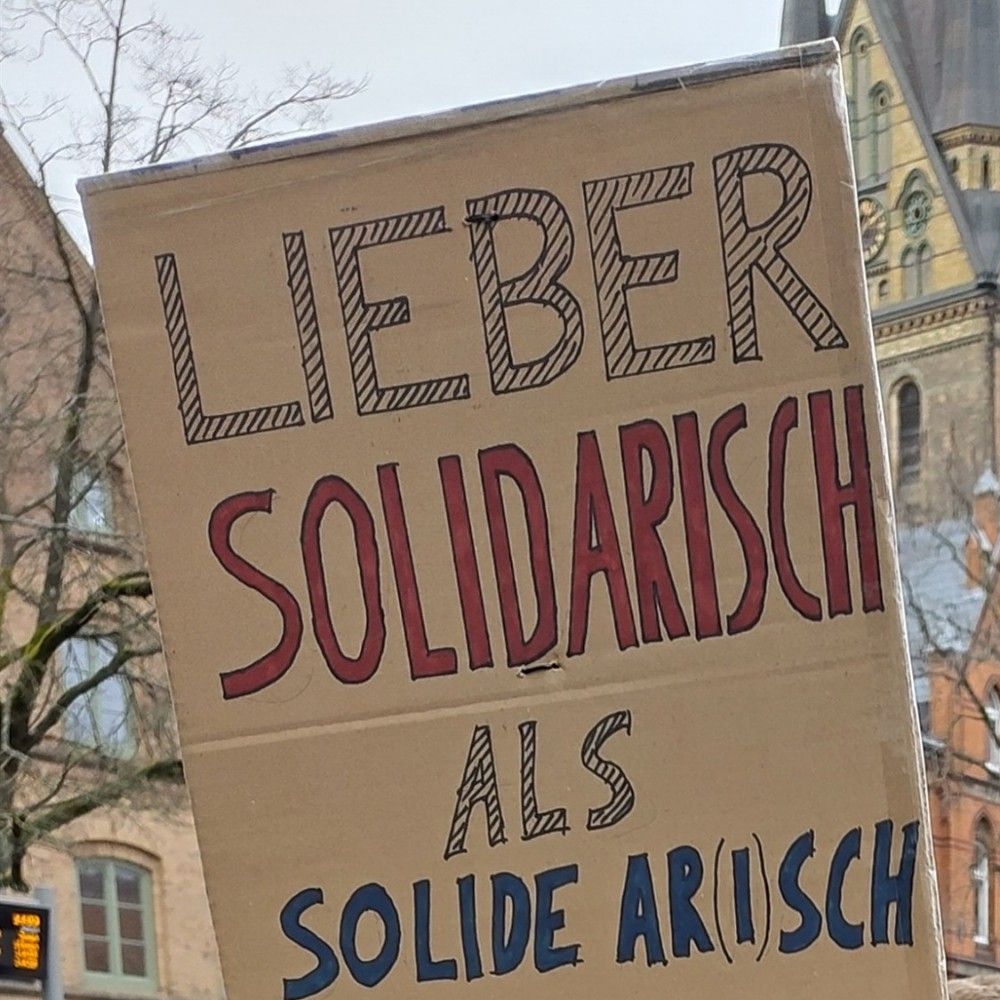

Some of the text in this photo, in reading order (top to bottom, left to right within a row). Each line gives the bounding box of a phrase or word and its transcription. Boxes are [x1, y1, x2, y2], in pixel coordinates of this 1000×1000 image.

[155, 143, 849, 444] LIEBER
[208, 385, 885, 699] SOLIDARISCH
[444, 709, 636, 860] ALS
[616, 819, 921, 966] AR(I)SCH
